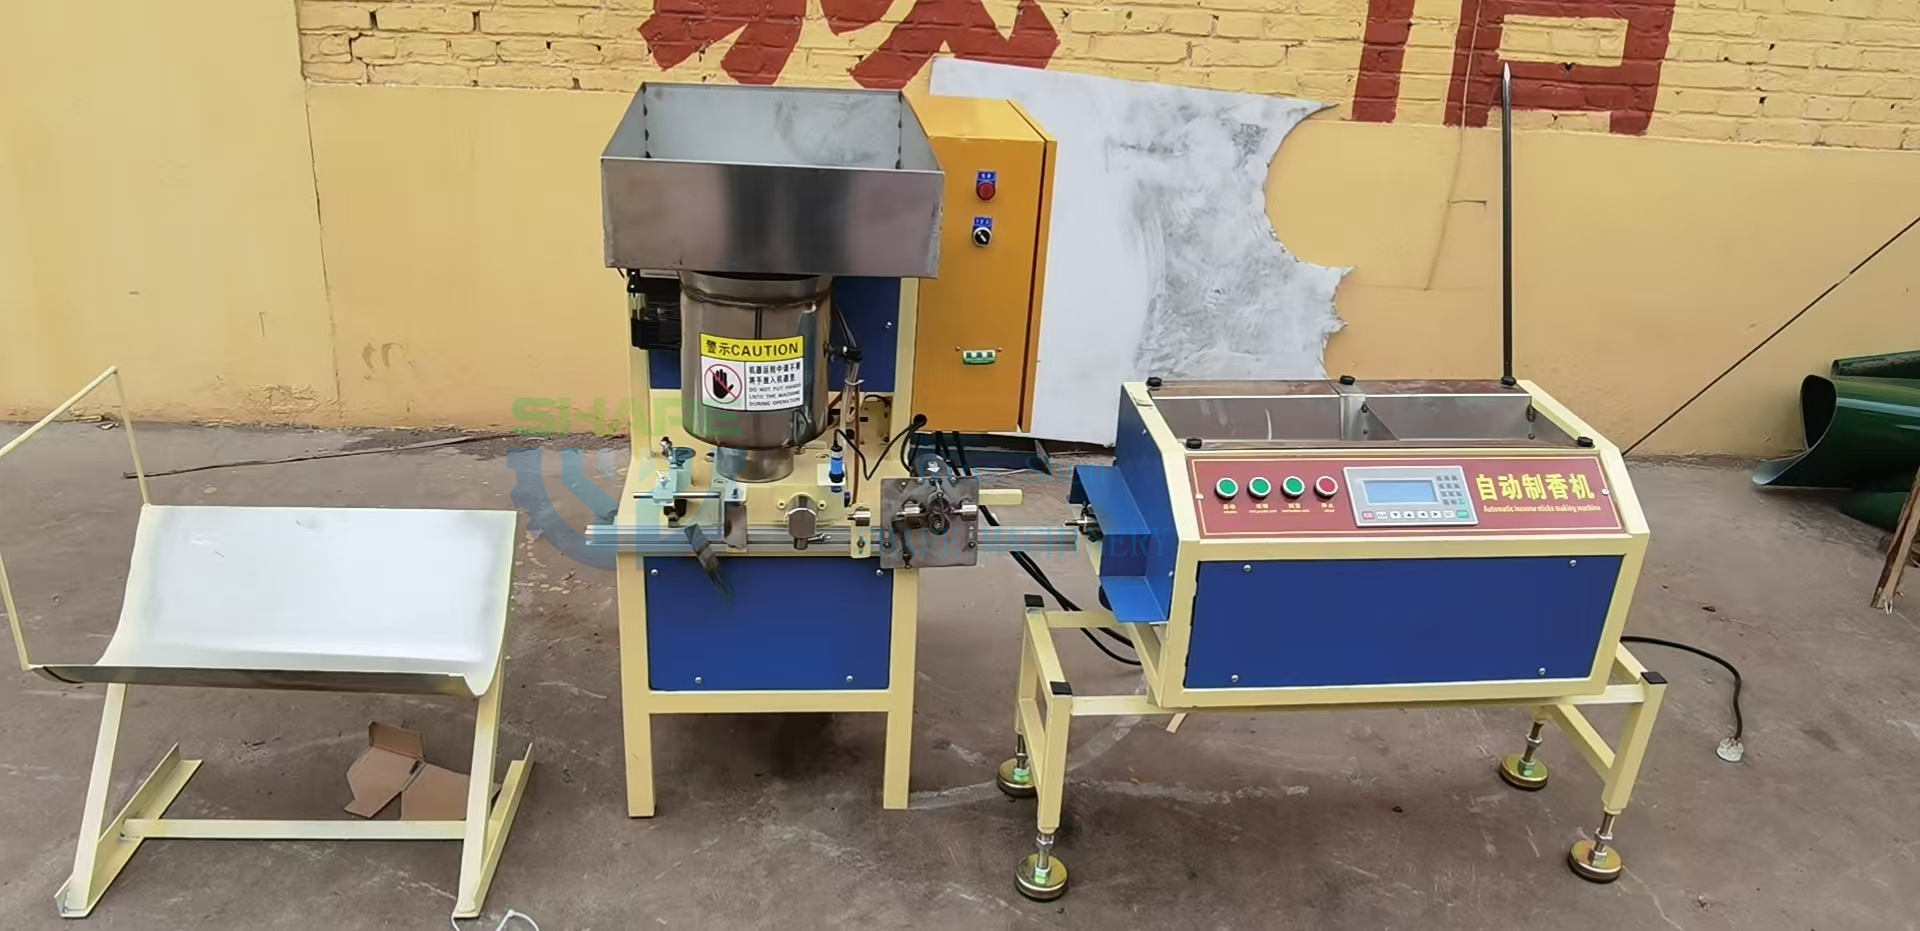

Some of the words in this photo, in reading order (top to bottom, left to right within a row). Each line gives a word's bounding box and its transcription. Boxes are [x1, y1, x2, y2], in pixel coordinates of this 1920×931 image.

[772, 397, 800, 405] OPERATION
[1476, 473, 1595, 501] 自动制香机
[1484, 505, 1513, 513] Automatic
[1537, 504, 1554, 512] sticks
[1555, 504, 1577, 513] making
[1577, 504, 1602, 512] machine
